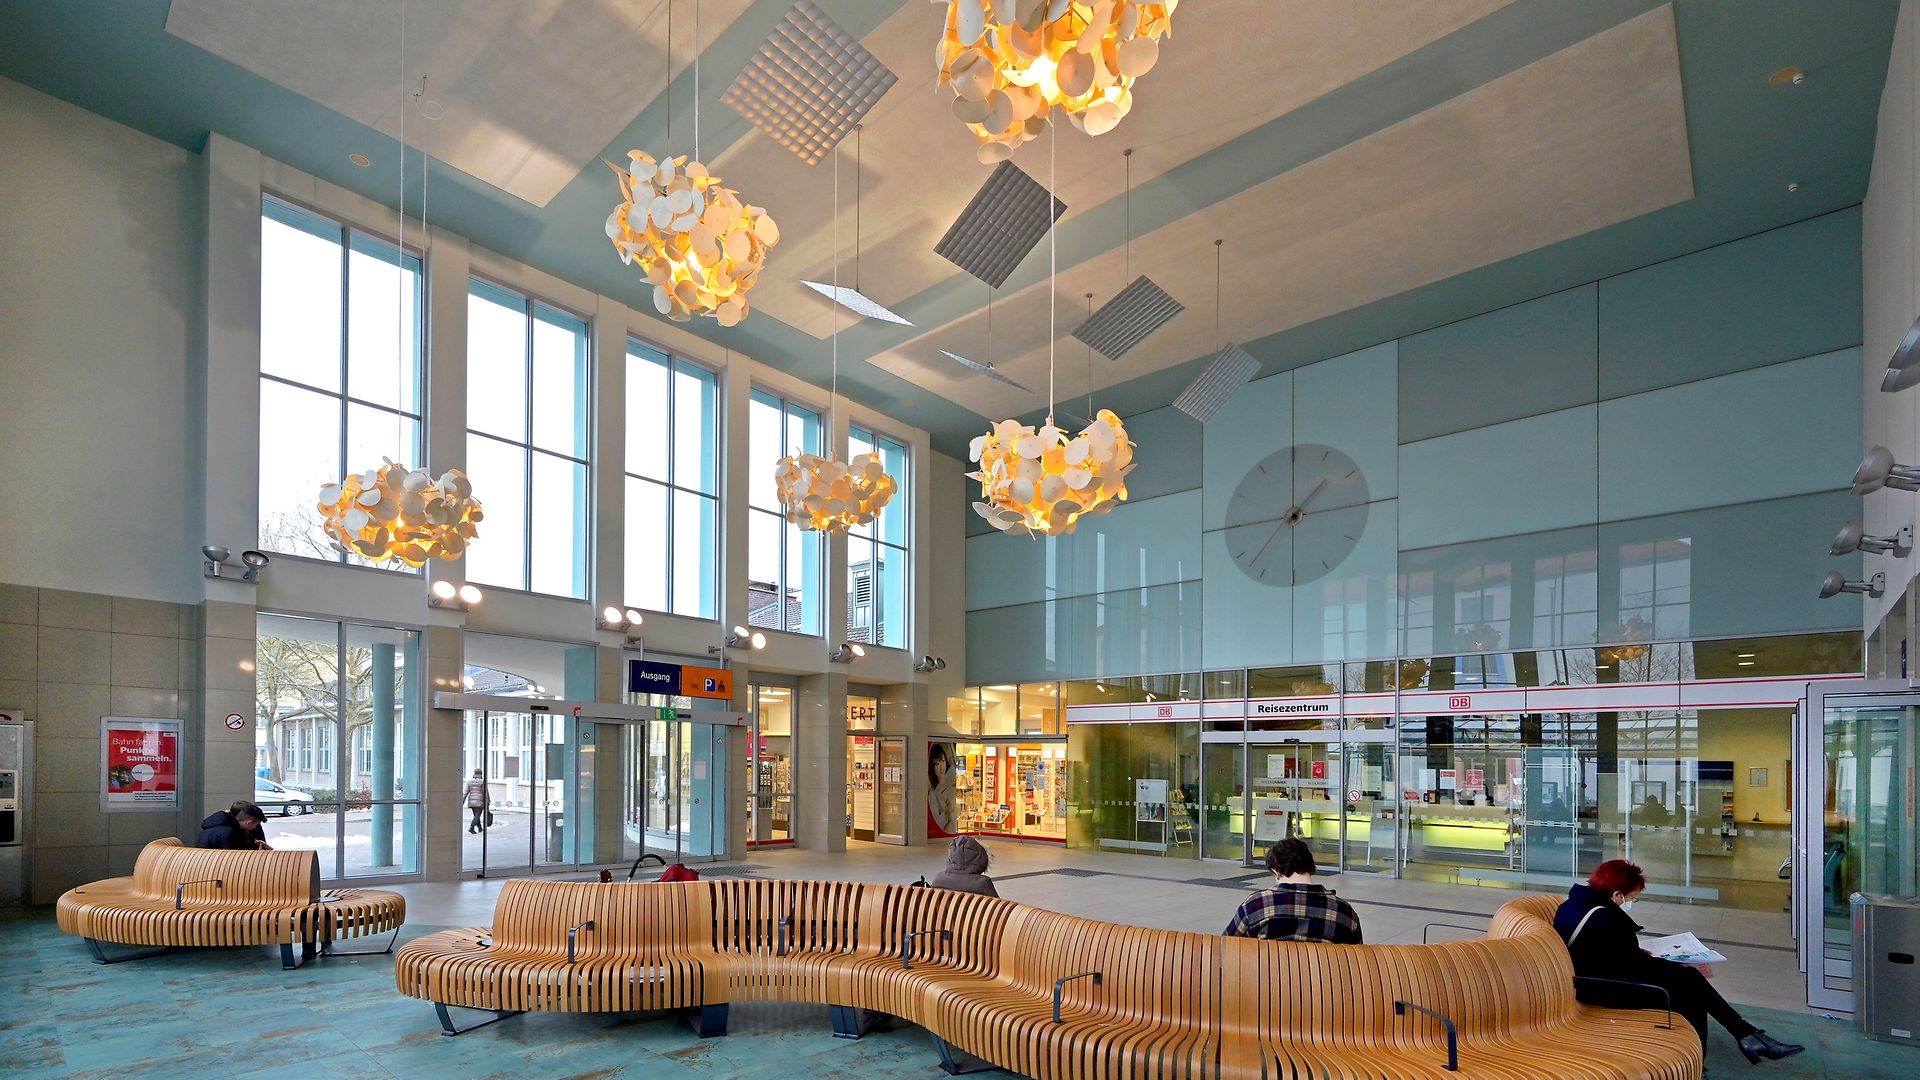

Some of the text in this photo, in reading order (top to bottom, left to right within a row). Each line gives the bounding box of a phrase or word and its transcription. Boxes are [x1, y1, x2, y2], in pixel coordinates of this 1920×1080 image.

[640, 671, 671, 683] Ausgang
[691, 678, 713, 691] WC P
[1451, 697, 1469, 708] DB
[847, 706, 875, 720] ERT
[1159, 708, 1171, 716] DB
[1258, 704, 1329, 714] Reisezentrum
